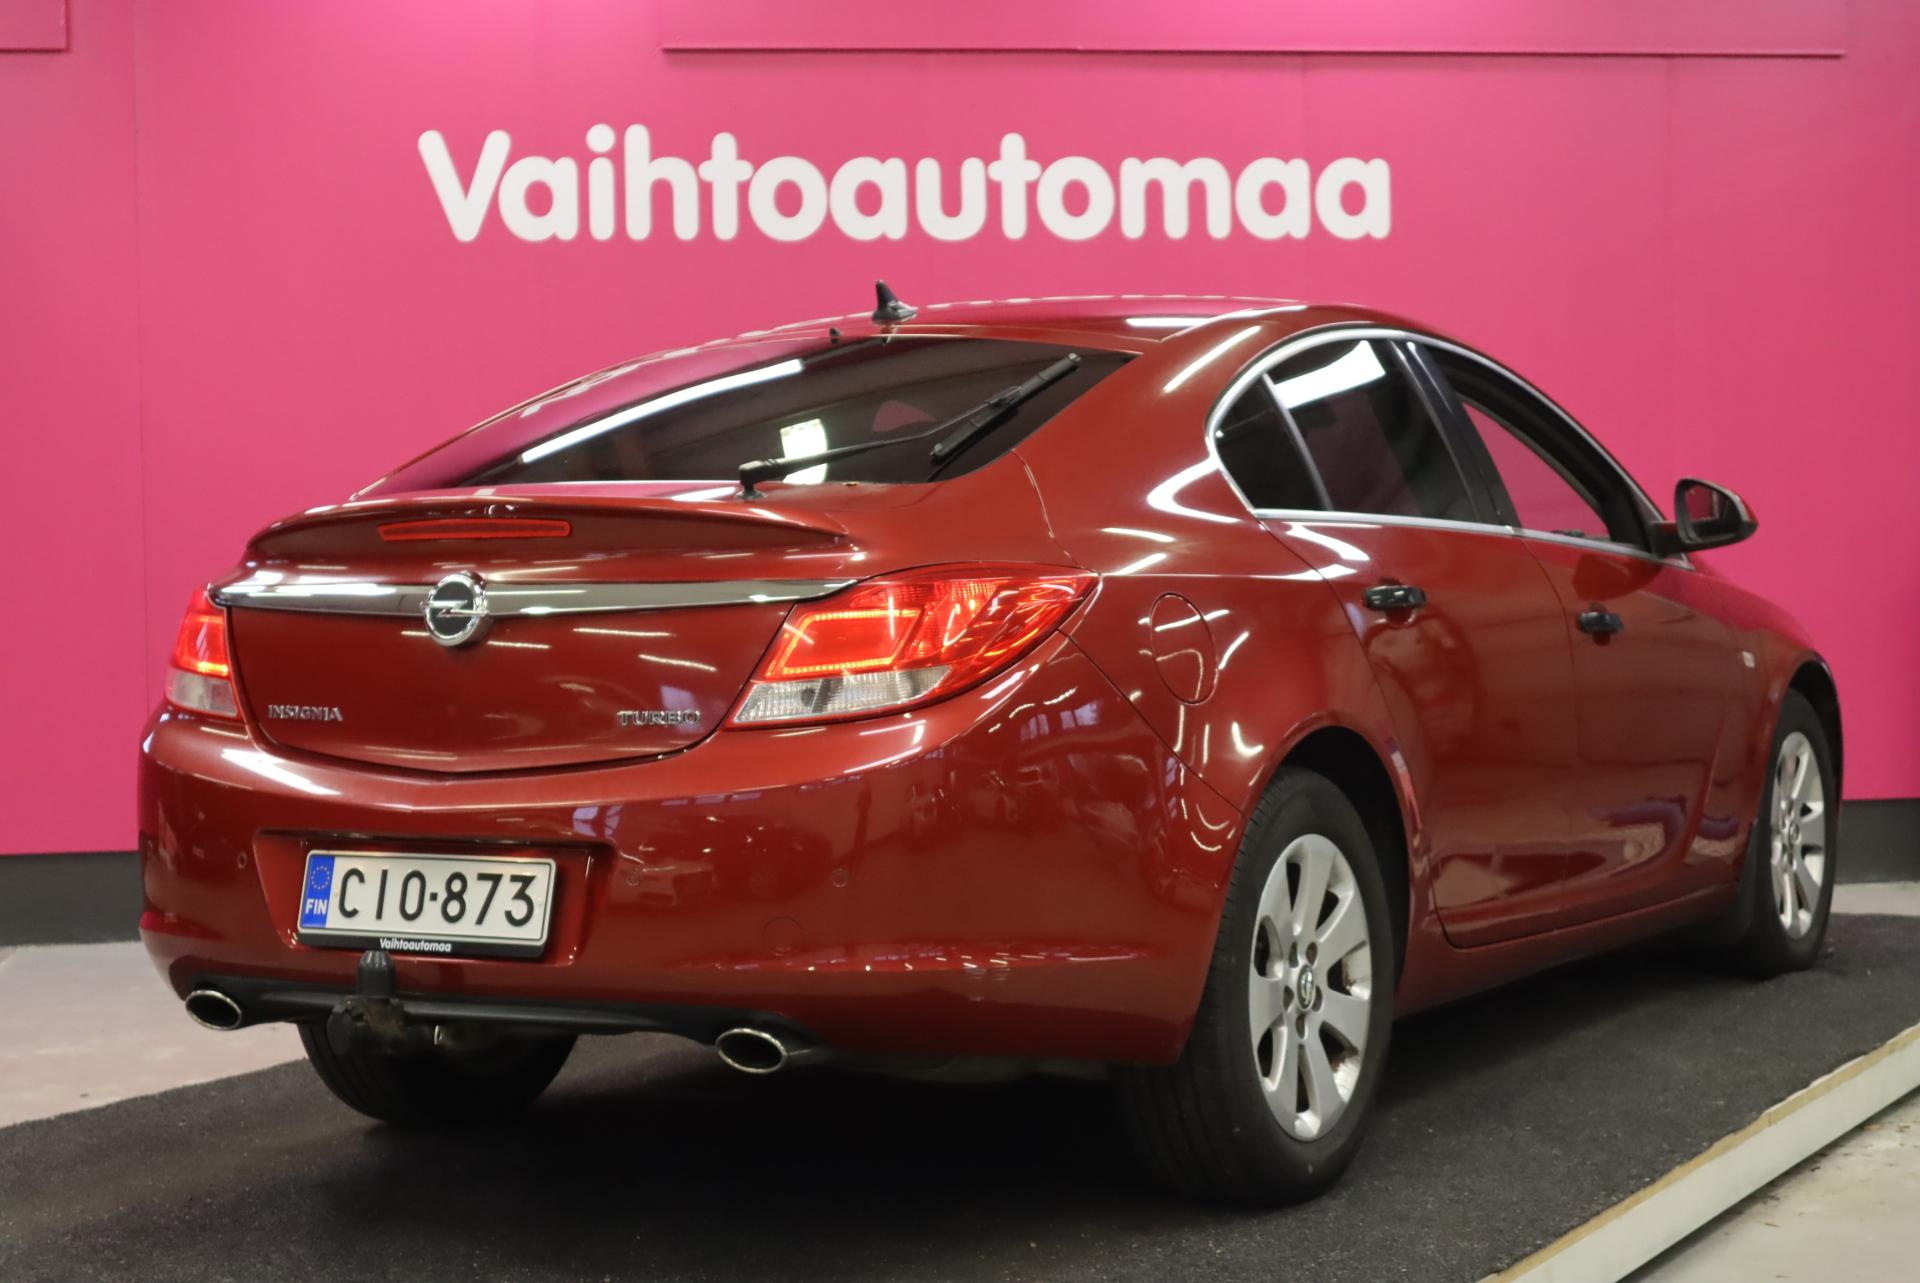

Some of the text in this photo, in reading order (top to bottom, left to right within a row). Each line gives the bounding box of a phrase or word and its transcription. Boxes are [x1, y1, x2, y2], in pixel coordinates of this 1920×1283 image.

[417, 123, 1391, 242] Vaihtoautomaa
[268, 704, 343, 721] INSIGNIA
[616, 709, 701, 726] TURBO
[338, 867, 537, 927] CIO-873
[305, 898, 327, 915] FIN
[379, 937, 452, 952] Vaihtoautomaa
